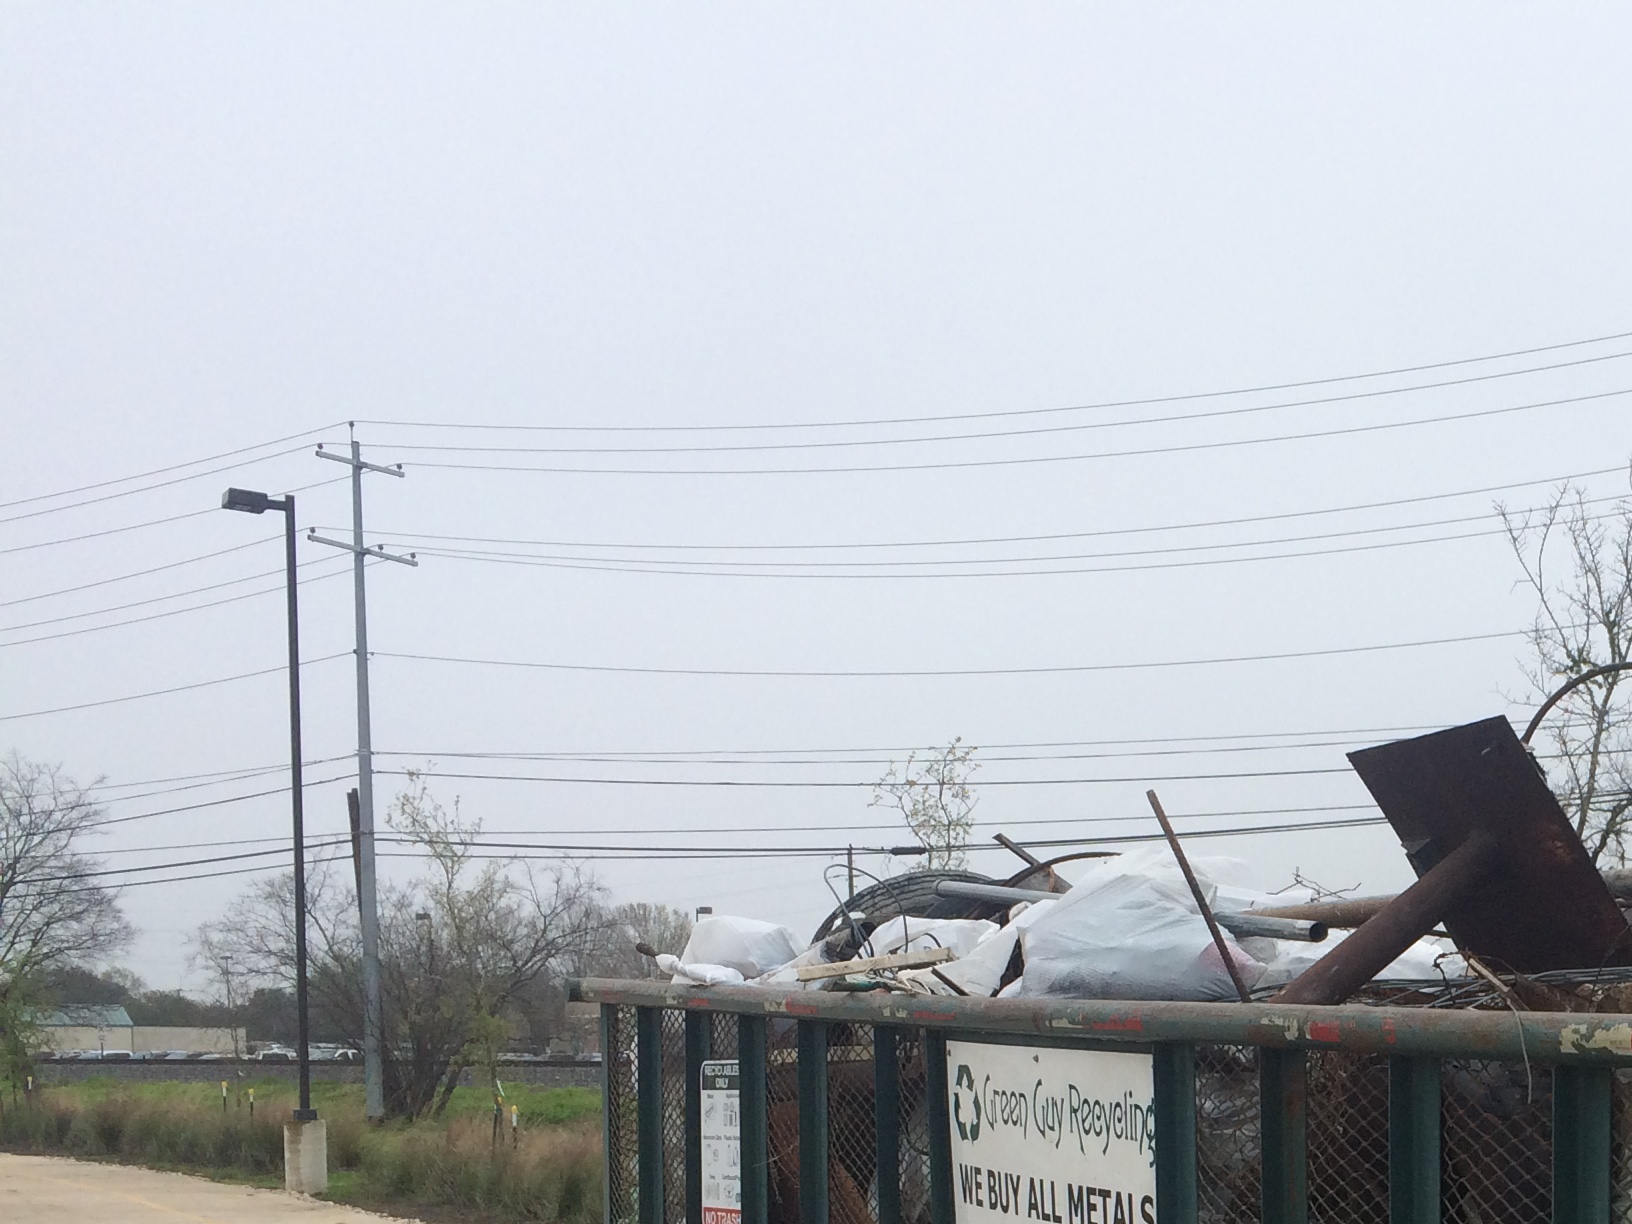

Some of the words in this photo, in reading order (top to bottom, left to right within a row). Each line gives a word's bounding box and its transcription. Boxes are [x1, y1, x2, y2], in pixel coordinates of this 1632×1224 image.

[983, 1073, 1028, 1140] Green
[1033, 1078, 1065, 1150] Guy
[1068, 1083, 1156, 1168] Recycling
[959, 1162, 984, 1208] WE
[987, 1168, 1021, 1216] BUY
[1027, 1176, 1063, 1224] ALL
